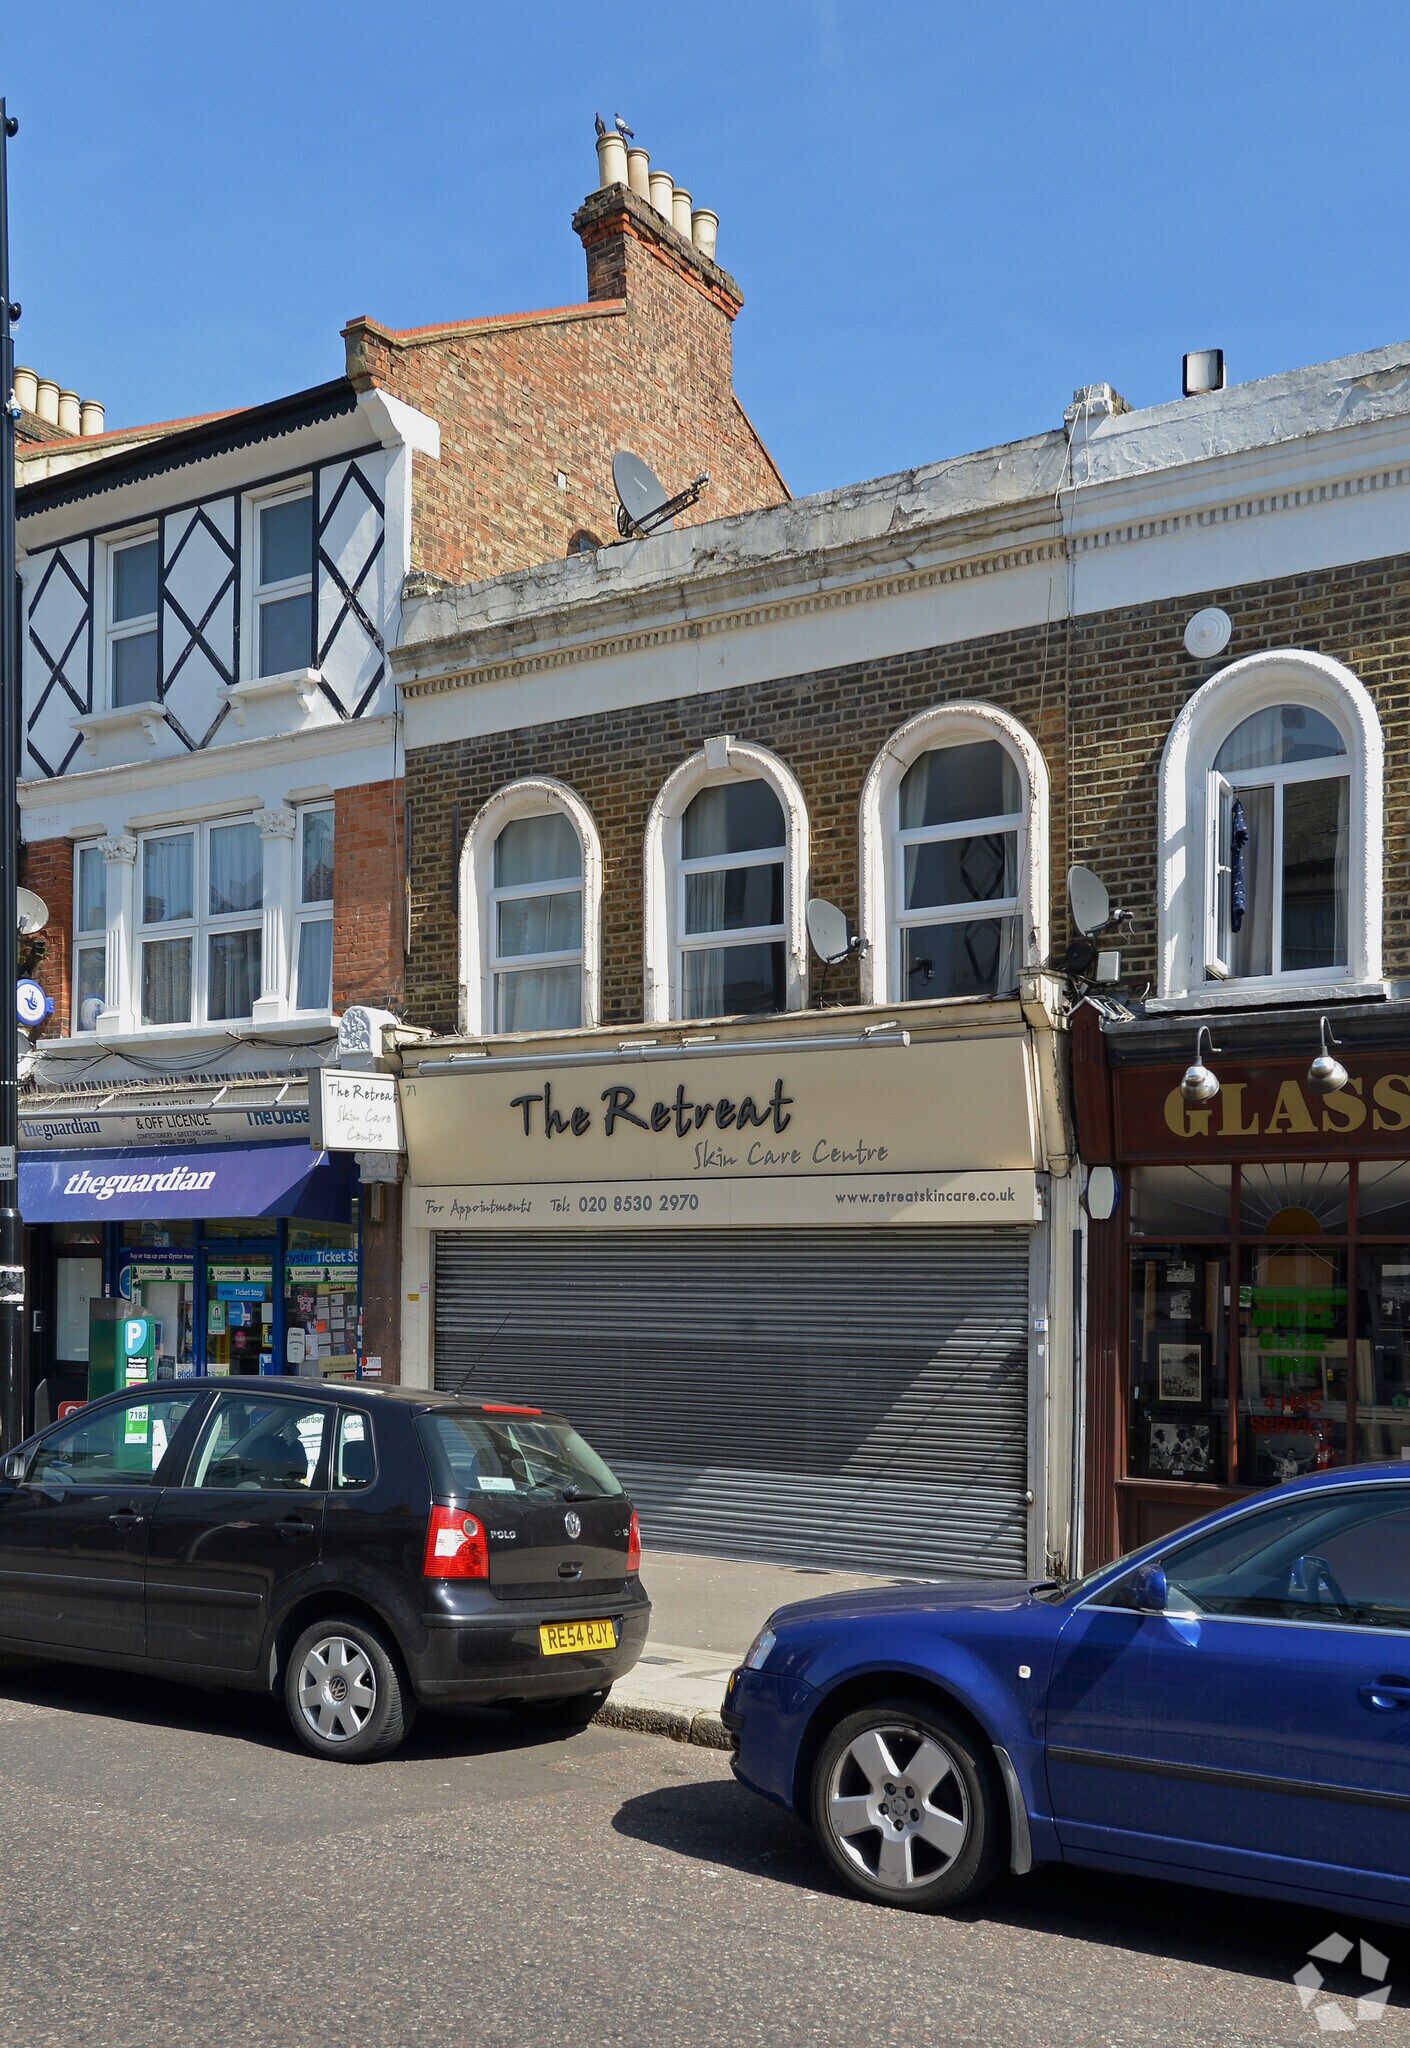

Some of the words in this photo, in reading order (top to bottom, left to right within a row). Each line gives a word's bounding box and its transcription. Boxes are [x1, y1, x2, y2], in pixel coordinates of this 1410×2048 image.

[328, 1081, 349, 1098] The
[353, 1085, 398, 1103] Retreat
[405, 1084, 417, 1097] 71
[337, 1105, 360, 1122] Skin
[365, 1108, 391, 1123] Care
[510, 1081, 591, 1139] The
[601, 1078, 793, 1138] Retreat
[1164, 1074, 1410, 1138] GLASS
[21, 1117, 102, 1141] theguardian
[136, 1117, 145, 1129] &
[145, 1116, 163, 1129] OFF
[166, 1112, 212, 1128] LICENCE
[347, 1126, 383, 1143] Centre
[694, 1140, 738, 1170] Skin
[747, 1141, 801, 1166] Care
[811, 1138, 889, 1165] Centre
[63, 1166, 216, 1201] theguardian
[835, 1187, 1016, 1204] www.retreatskincare.co.uk
[425, 1200, 445, 1214] For
[450, 1199, 531, 1221] Appointments
[550, 1196, 571, 1213] Tel:
[578, 1196, 607, 1212] 020
[613, 1195, 652, 1212] 8530
[659, 1194, 699, 1211] 2970
[316, 1251, 346, 1263] Ticket
[1282, 1391, 1324, 1412] HRS
[129, 1411, 147, 1419] 7182
[1250, 1415, 1336, 1438] SERVICE
[490, 1530, 517, 1539] POLO
[547, 1625, 584, 1649] RE54
[586, 1623, 608, 1645] RJY
